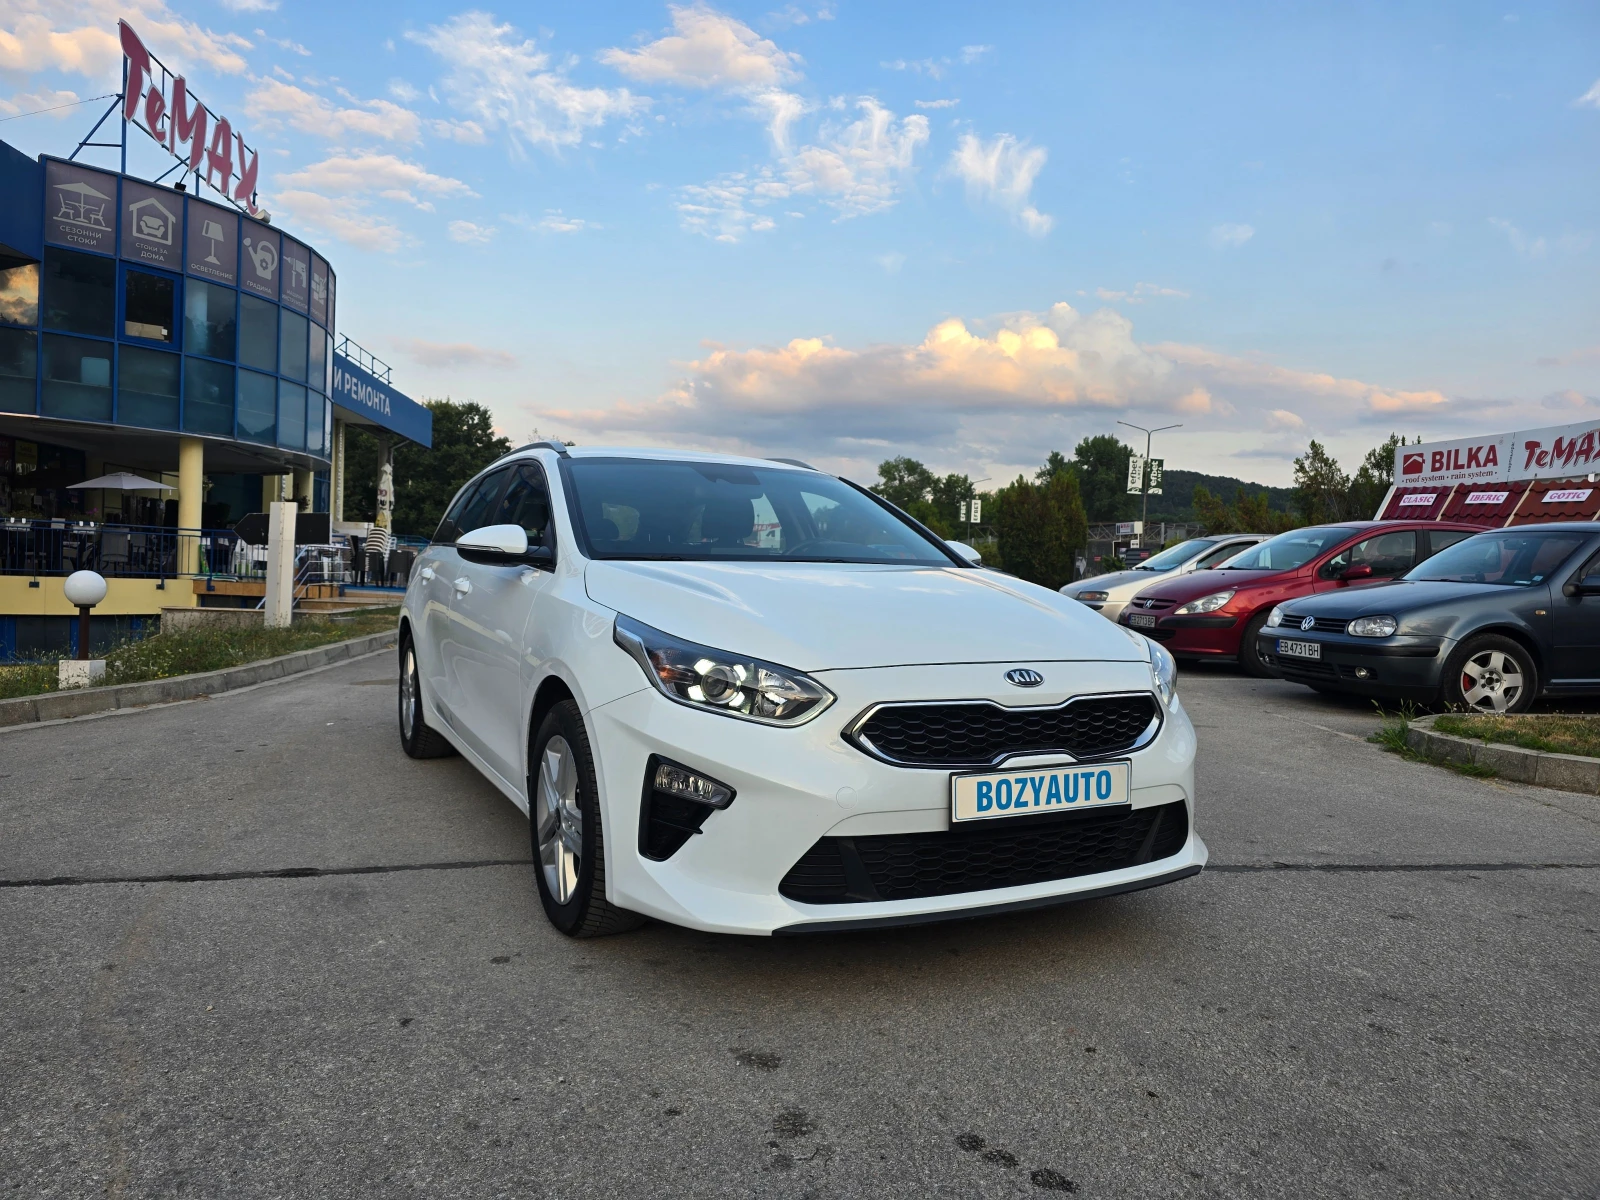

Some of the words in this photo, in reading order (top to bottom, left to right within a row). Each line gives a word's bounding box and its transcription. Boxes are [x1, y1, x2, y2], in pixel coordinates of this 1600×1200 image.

[59, 225, 102, 239] СЕЗОННИ
[67, 234, 97, 246] СТОКИ
[135, 242, 158, 252] СТОКИ
[159, 247, 168, 255] ЗА
[140, 250, 165, 262] ДОМА
[190, 263, 233, 280] ОСВЕТЛЕНИЕ
[246, 280, 272, 294] ГРАДИНА
[334, 366, 342, 390] И
[344, 372, 391, 417] РЕМОНТА
[1523, 431, 1600, 471] TeMA
[1431, 444, 1498, 472] BILKA
[1405, 475, 1421, 483] roof
[1421, 474, 1445, 483] system
[1451, 471, 1466, 480] rain
[1467, 470, 1494, 480] system
[1469, 494, 1504, 502] IBERIC
[1549, 491, 1586, 500] GOTIC
[1010, 671, 1042, 683] KIA
[976, 770, 1112, 812] BOZYAUTO
